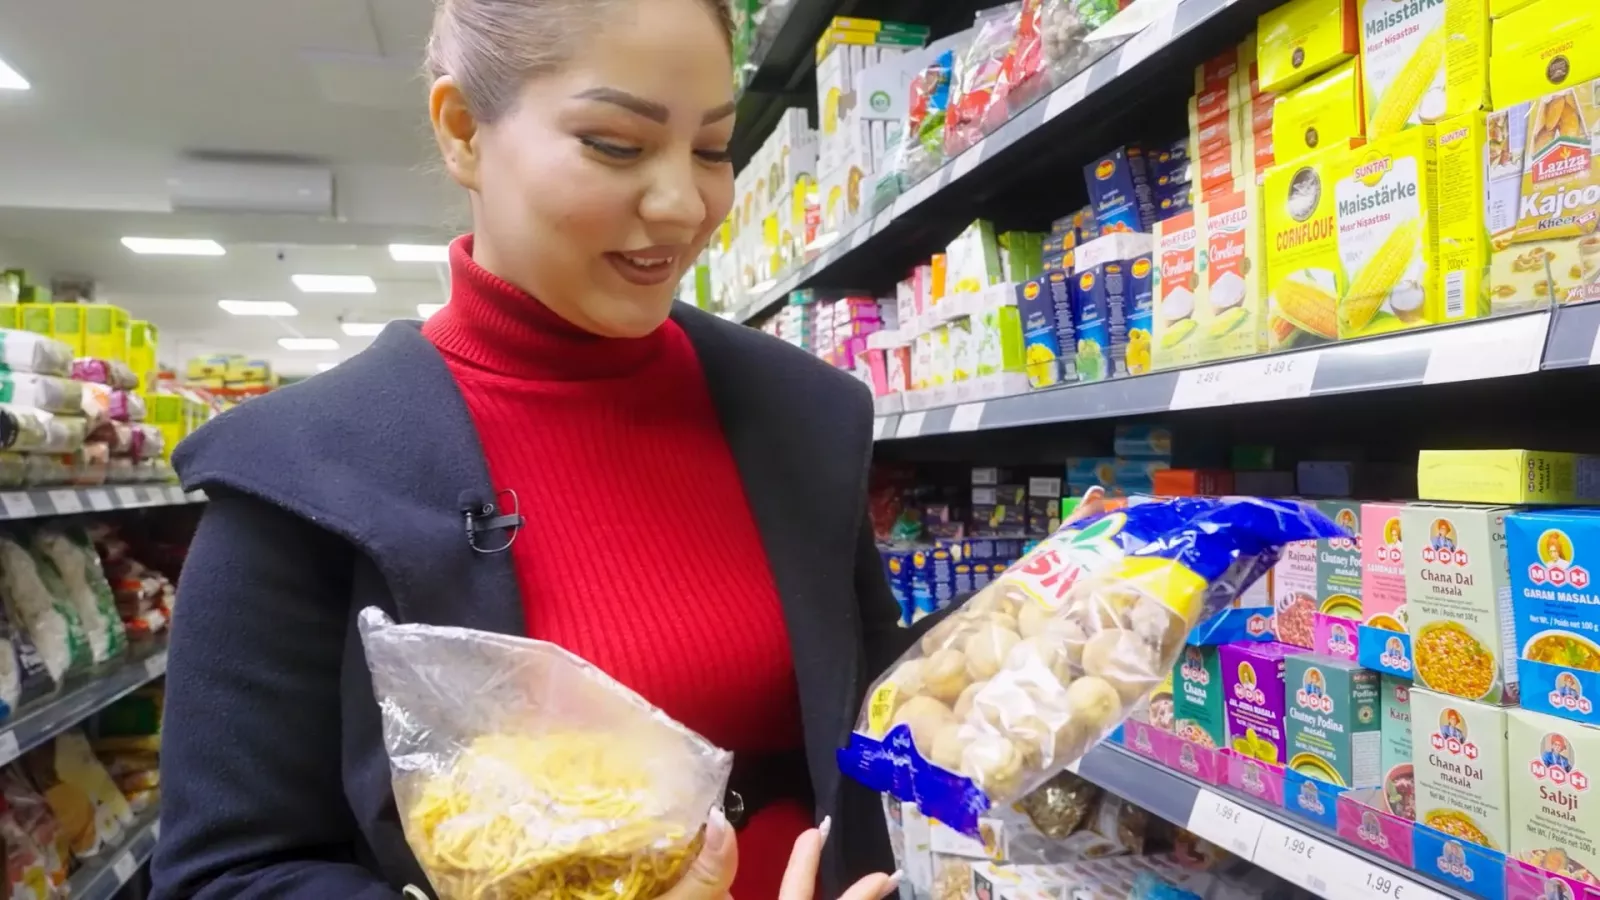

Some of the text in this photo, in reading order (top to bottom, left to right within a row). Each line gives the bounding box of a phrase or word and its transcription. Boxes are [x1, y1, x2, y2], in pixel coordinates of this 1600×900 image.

[1440, 129, 1468, 145] SUNTAT
[1355, 158, 1390, 179] SUNTAT
[1538, 154, 1586, 176] Laziza
[1339, 181, 1416, 218] Maisstärke
[1520, 184, 1600, 221] Kajoo
[1349, 555, 1362, 567] Po
[1423, 547, 1468, 566] MDH
[1420, 568, 1474, 586] Chana Dal
[1530, 563, 1589, 588] MDH
[1432, 584, 1463, 597] masala
[1523, 587, 1600, 606] GARAM MASALA
[1549, 692, 1593, 714] MDH
[1431, 733, 1478, 760] MDH
[1429, 754, 1483, 781] Chana Dal
[1530, 760, 1588, 792] MDH
[1440, 771, 1472, 789] masala
[1539, 785, 1579, 811] Sabji
[1541, 805, 1577, 823] masala
[1307, 846, 1316, 859] €
[1394, 885, 1404, 900] €
